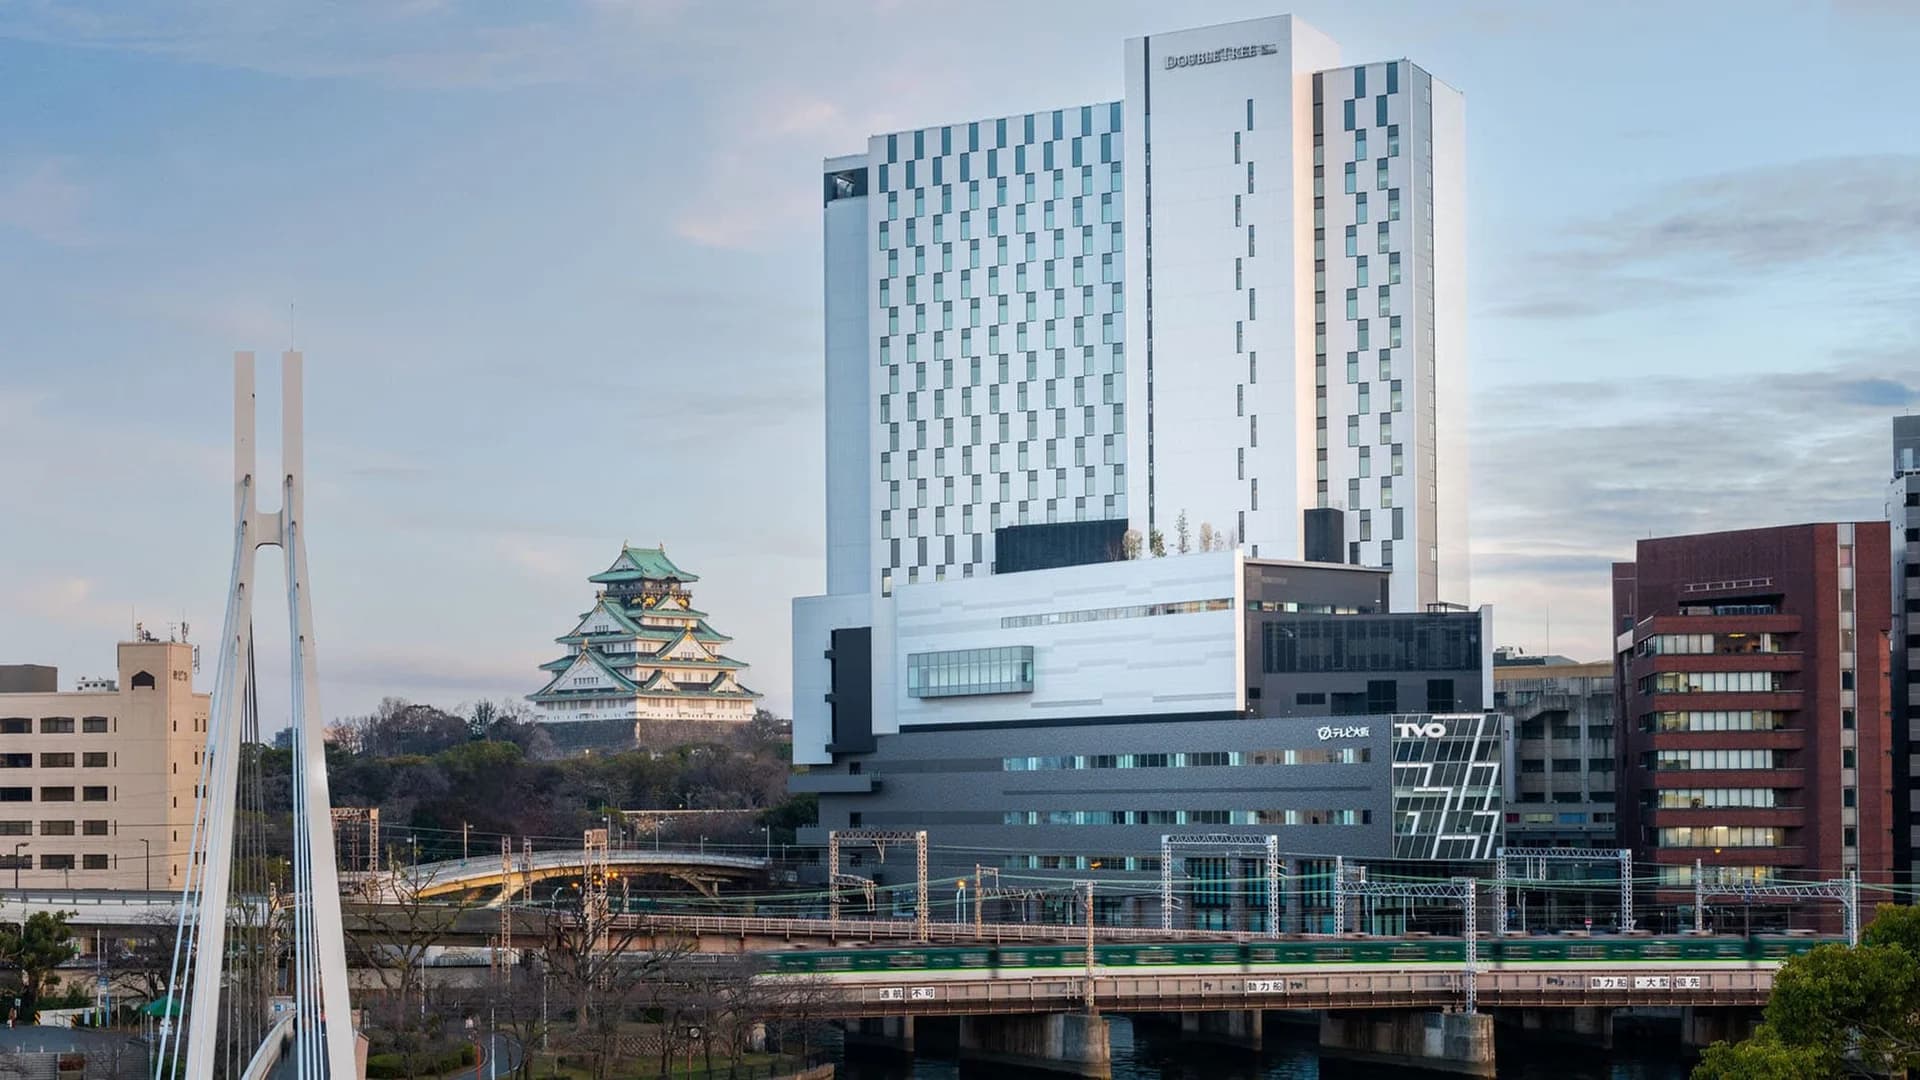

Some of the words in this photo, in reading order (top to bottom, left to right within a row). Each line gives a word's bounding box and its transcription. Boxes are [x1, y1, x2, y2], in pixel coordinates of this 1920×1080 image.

[1331, 726, 1369, 738] テレビ大阪
[1394, 723, 1447, 739] TVO
